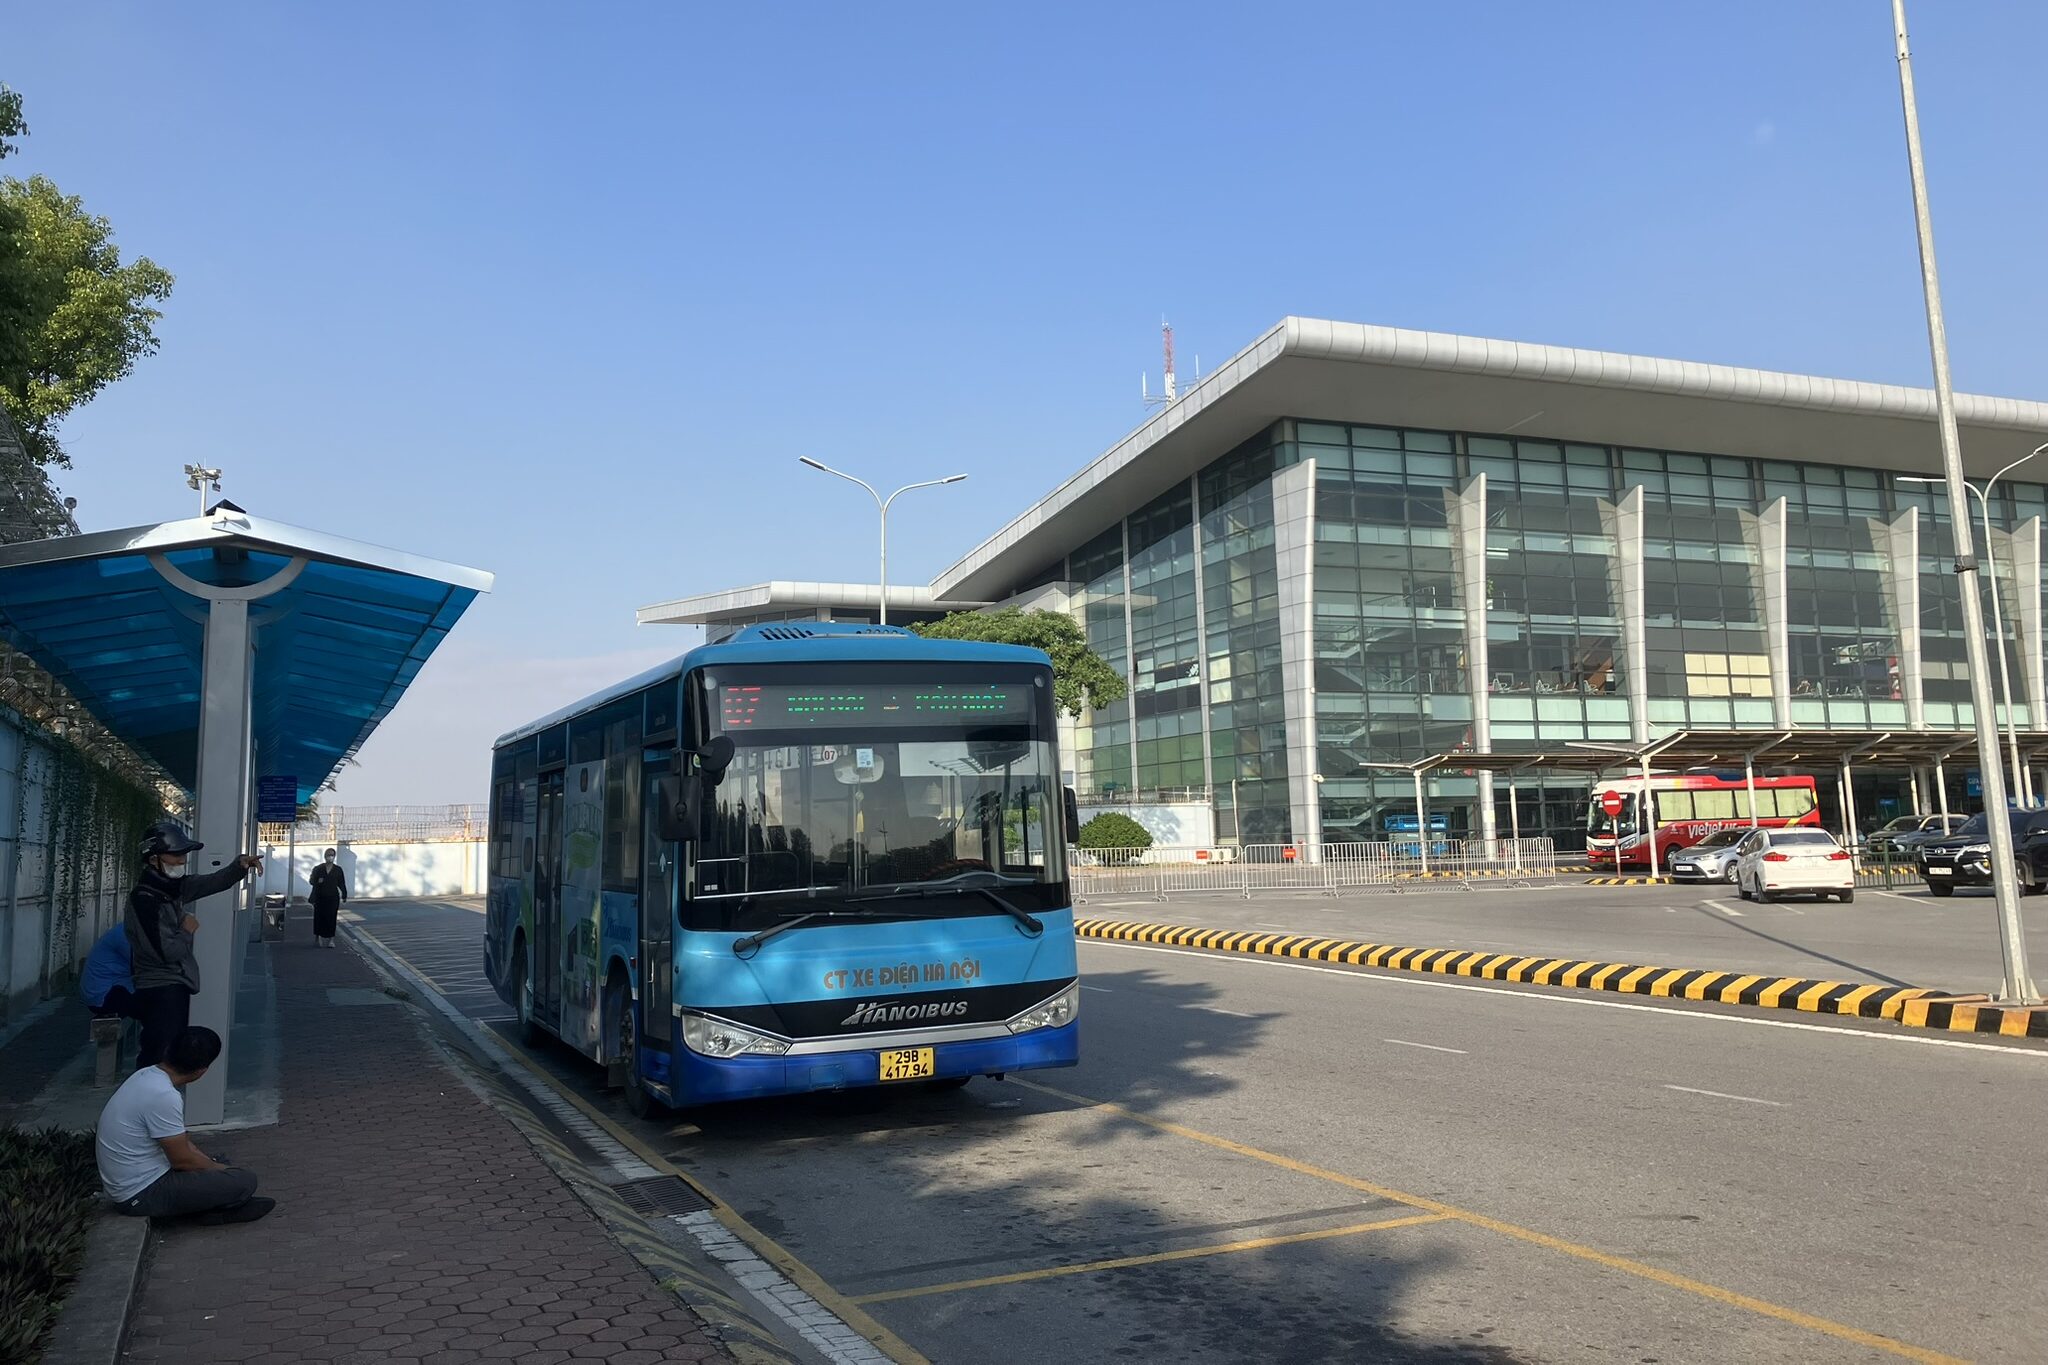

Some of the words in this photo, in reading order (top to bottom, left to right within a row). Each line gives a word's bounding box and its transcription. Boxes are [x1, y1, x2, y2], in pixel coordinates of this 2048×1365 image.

[823, 750, 835, 761] 07
[823, 970, 848, 989] CT
[852, 968, 873, 987] XE
[879, 962, 919, 989] ĐIỆN
[923, 960, 945, 982] HÀ
[951, 958, 980, 984] NỘI
[841, 1001, 968, 1025] HANOIBUS
[896, 1050, 919, 1064] 29B
[885, 1062, 928, 1079] 417.94
